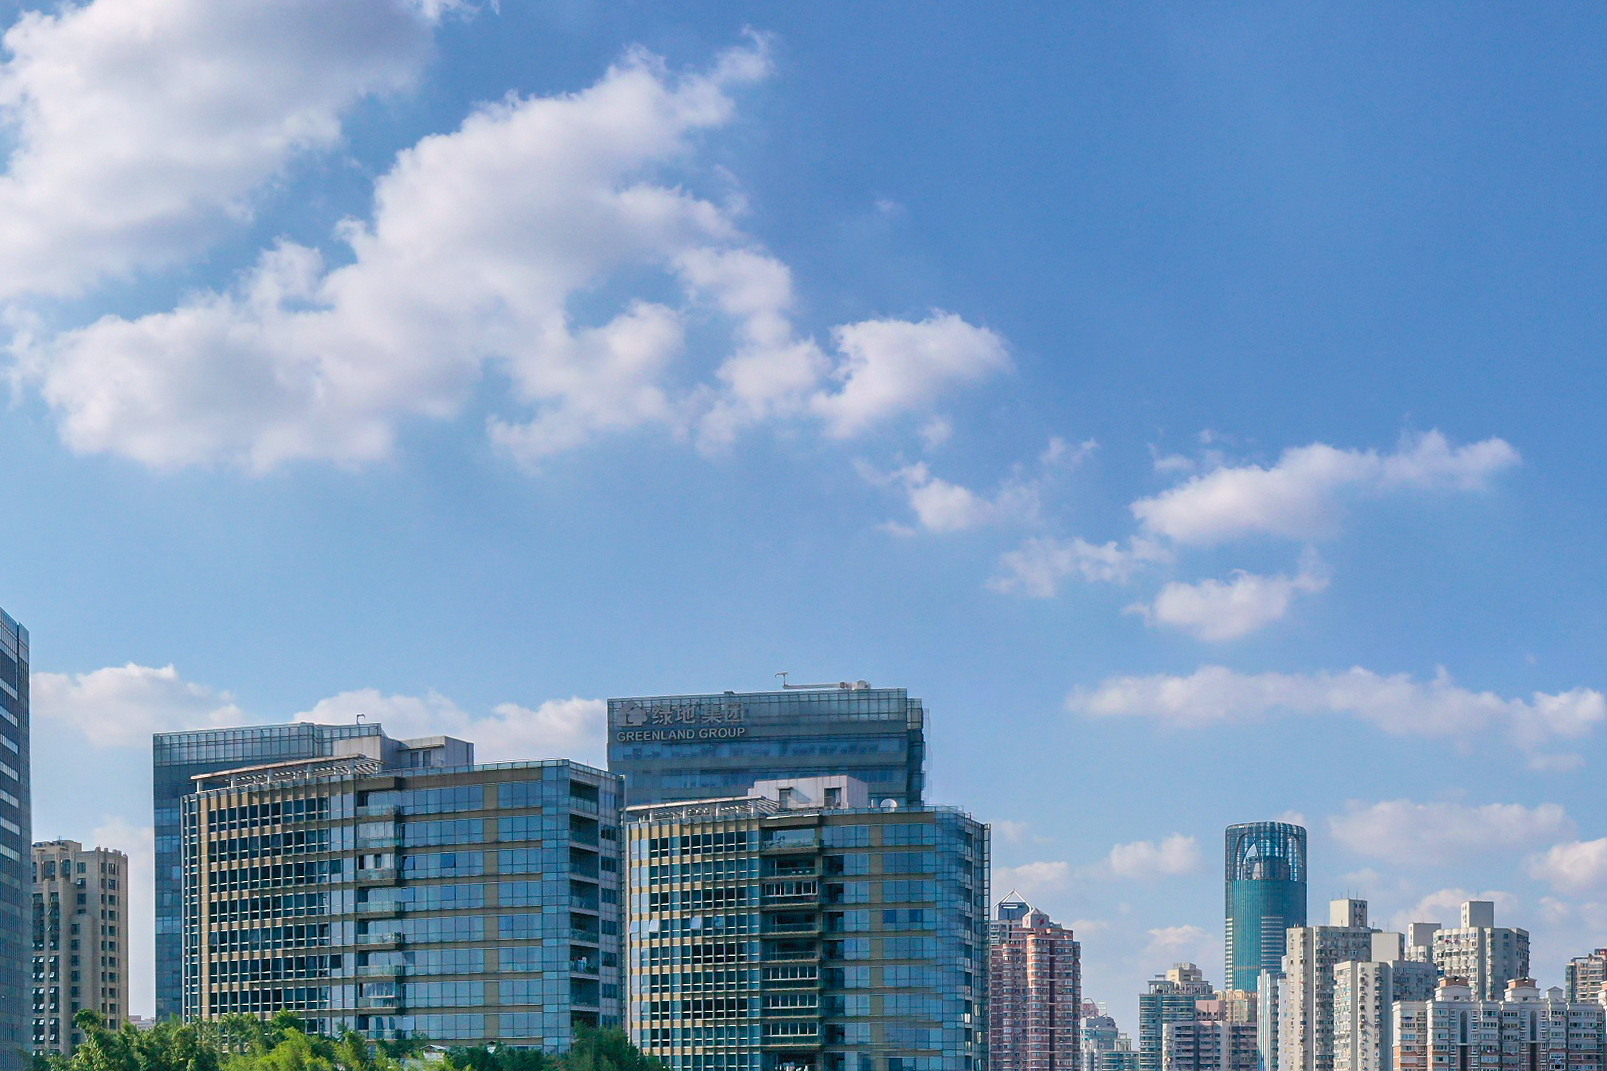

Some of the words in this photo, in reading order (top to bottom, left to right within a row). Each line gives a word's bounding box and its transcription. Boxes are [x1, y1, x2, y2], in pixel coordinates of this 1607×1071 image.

[651, 701, 745, 725] 绿地集团
[616, 729, 695, 742] GREENLAND
[698, 727, 746, 739] GROUP
